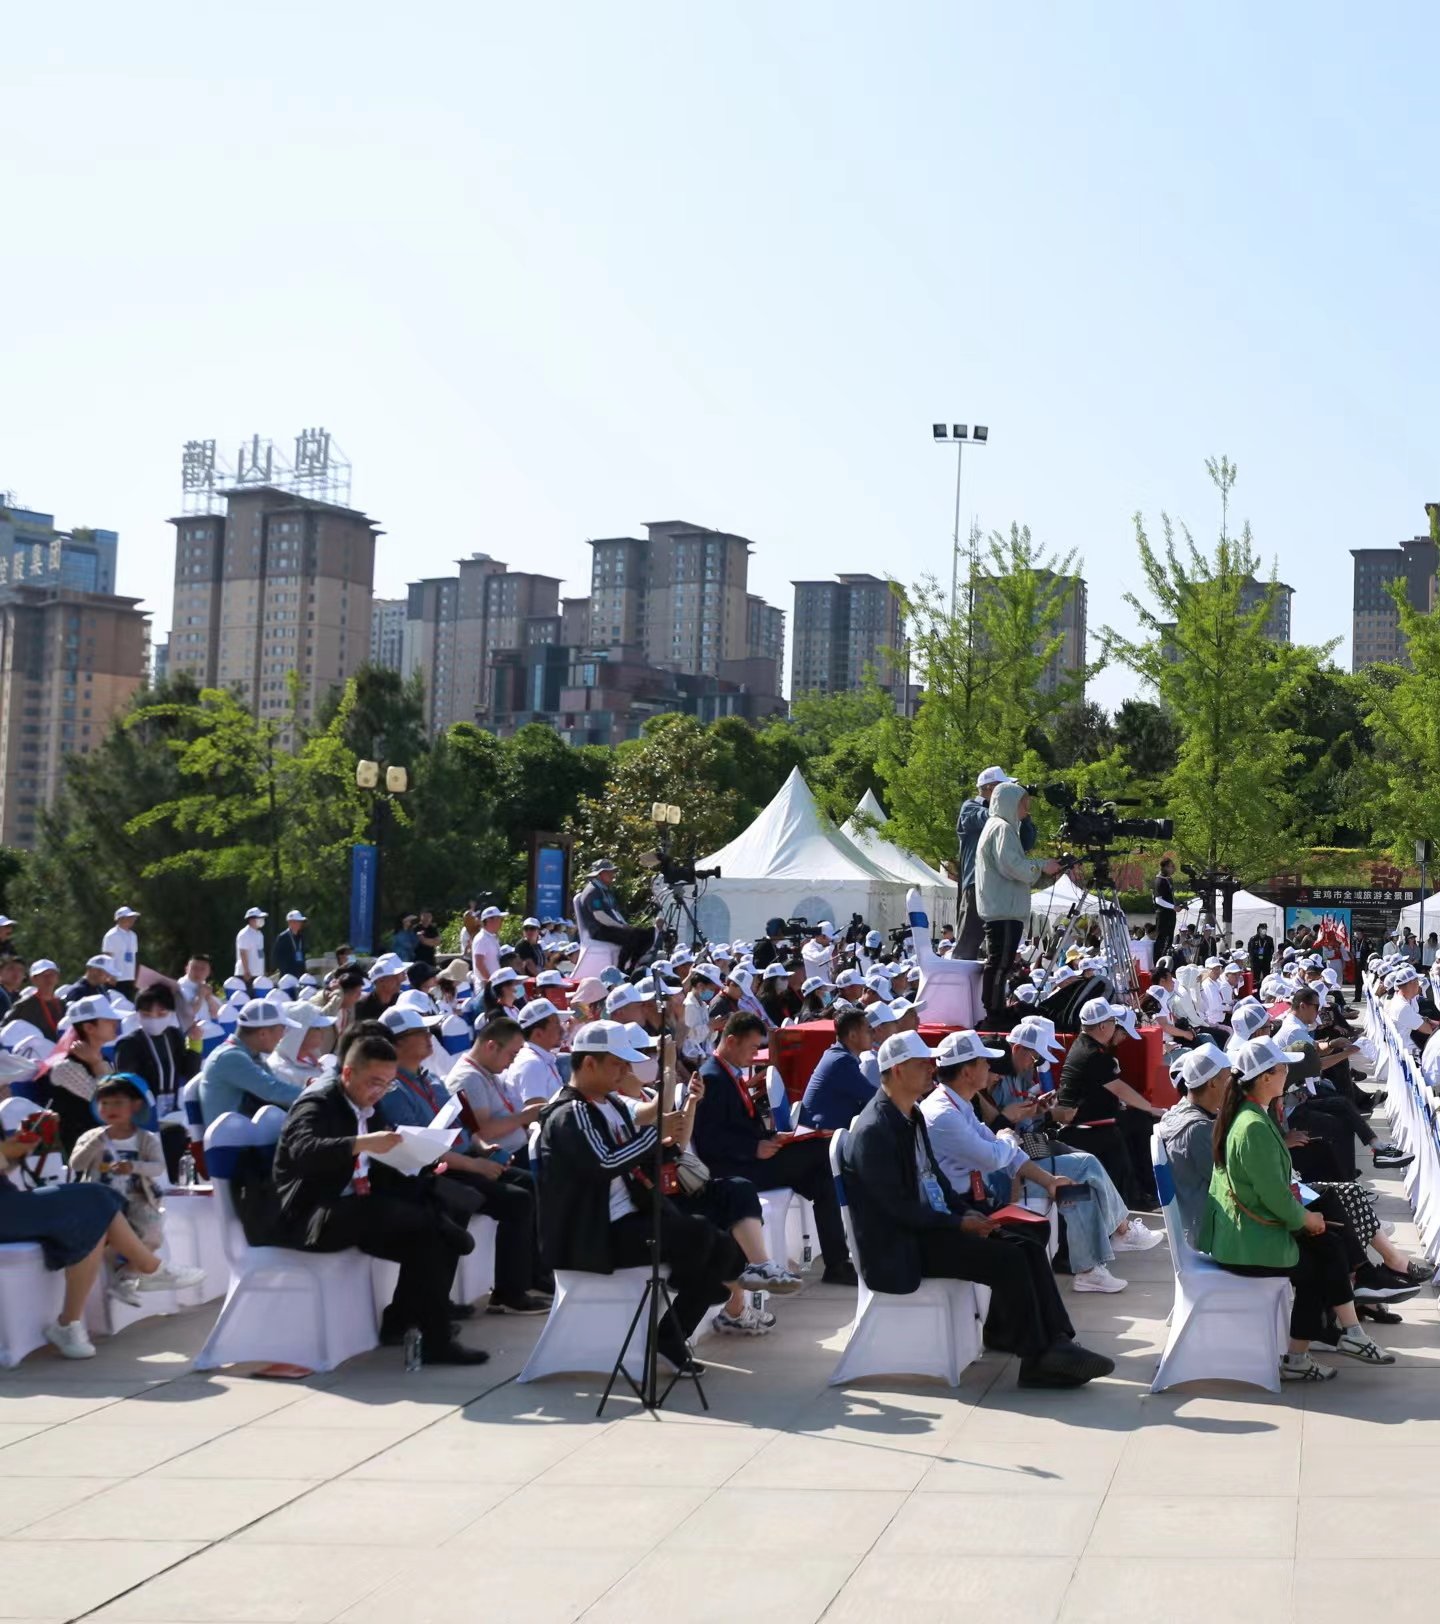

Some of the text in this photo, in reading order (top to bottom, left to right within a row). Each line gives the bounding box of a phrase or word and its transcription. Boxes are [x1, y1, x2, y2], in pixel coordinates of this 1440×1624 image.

[1312, 890, 1414, 902] 宝鸡市全域旅游全景图
